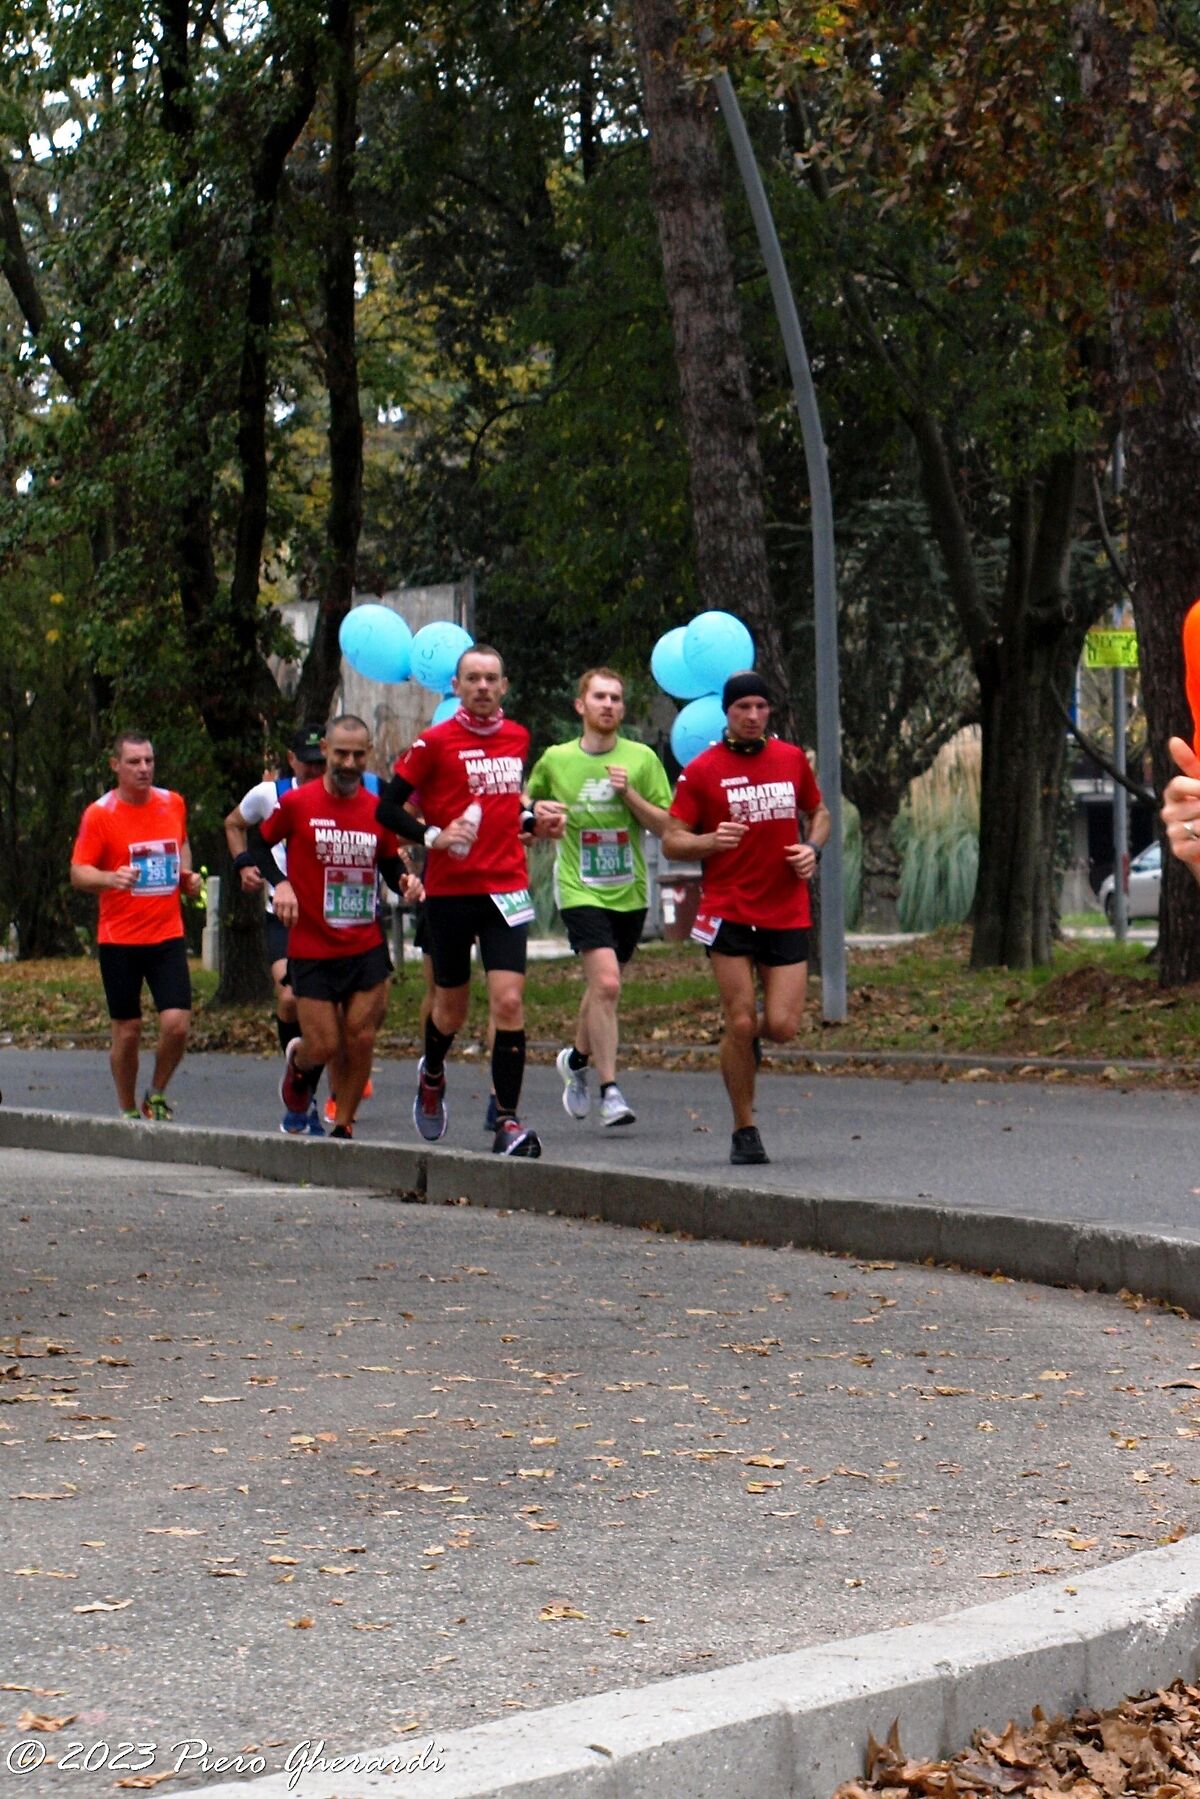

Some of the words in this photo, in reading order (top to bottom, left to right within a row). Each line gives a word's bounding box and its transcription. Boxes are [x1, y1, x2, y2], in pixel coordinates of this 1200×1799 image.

[465, 757, 523, 774] MARATONA
[726, 781, 796, 803] MARATONA
[315, 828, 377, 848] MARATONA
